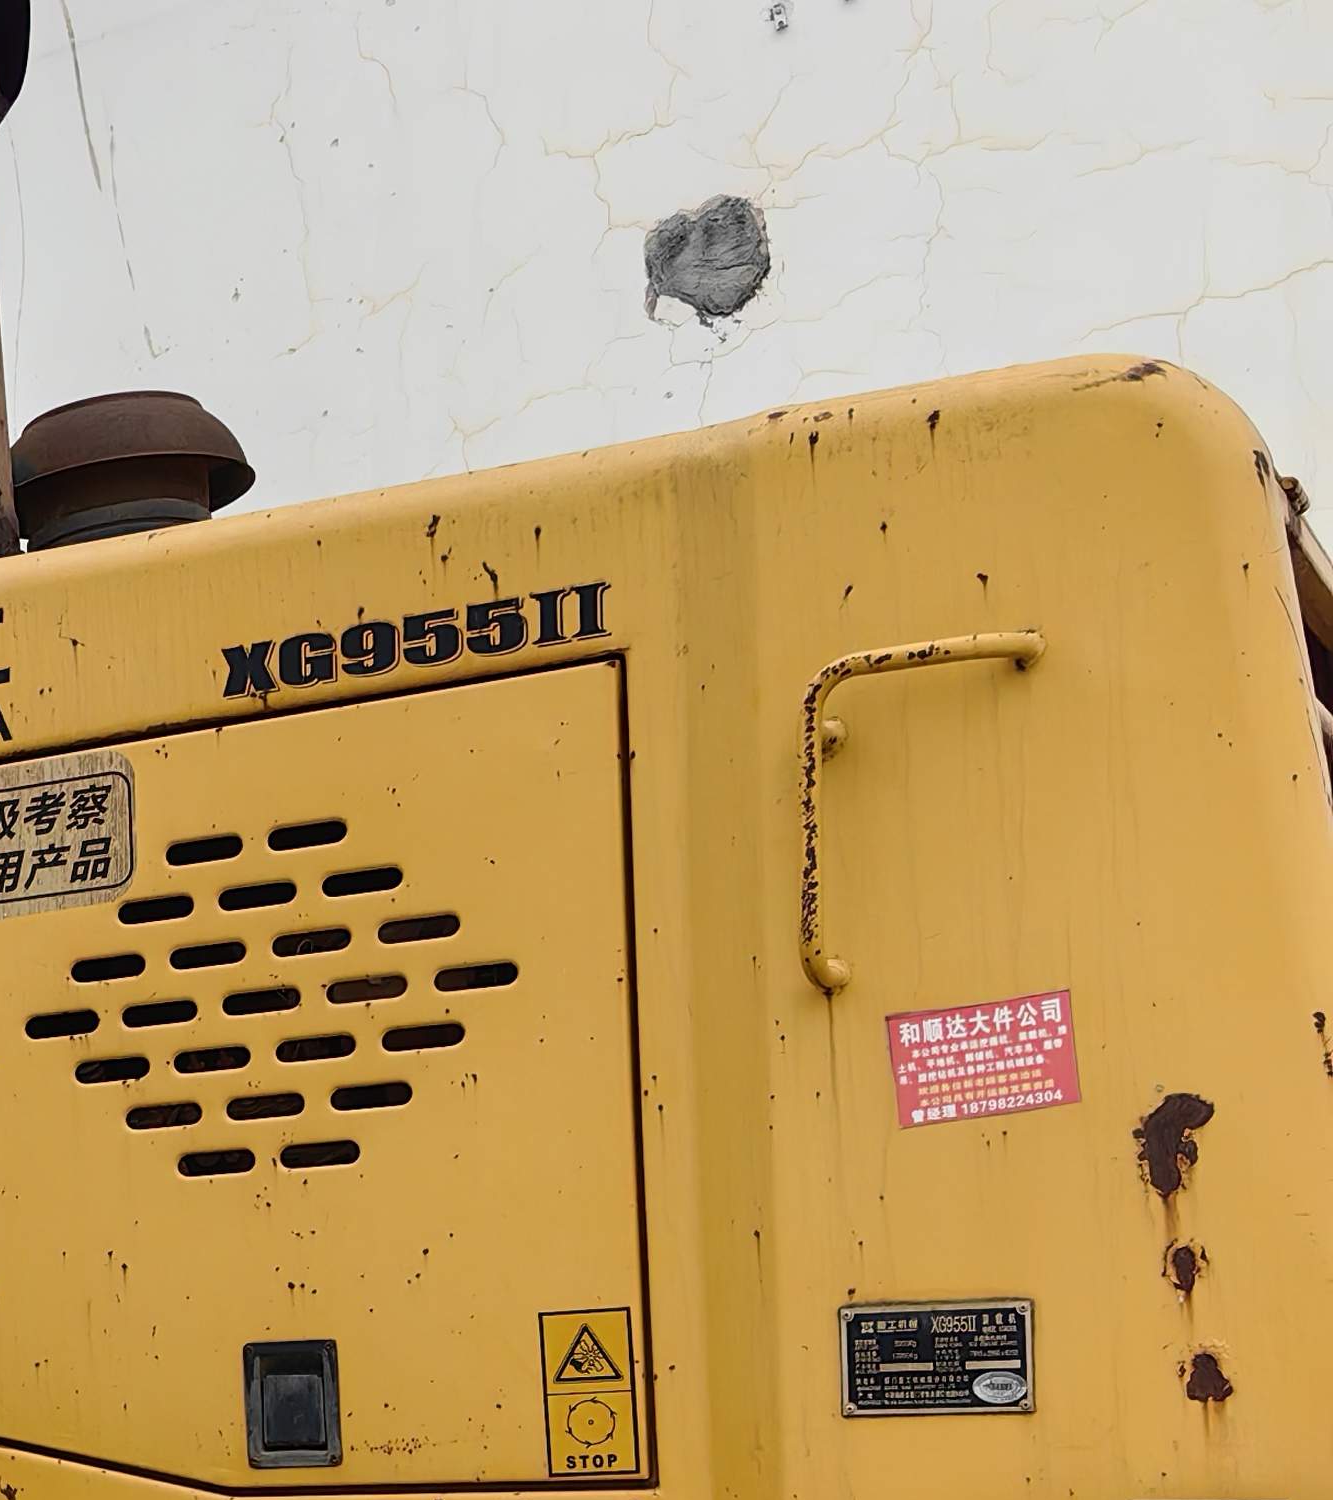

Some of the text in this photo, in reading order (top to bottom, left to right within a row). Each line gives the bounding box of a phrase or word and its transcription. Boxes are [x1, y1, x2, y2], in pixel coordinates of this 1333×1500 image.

[899, 998, 1062, 1047] 和顺达大件公司
[911, 1089, 1063, 1123] 曾经理 18798224304
[566, 1454, 618, 1469] STOP
